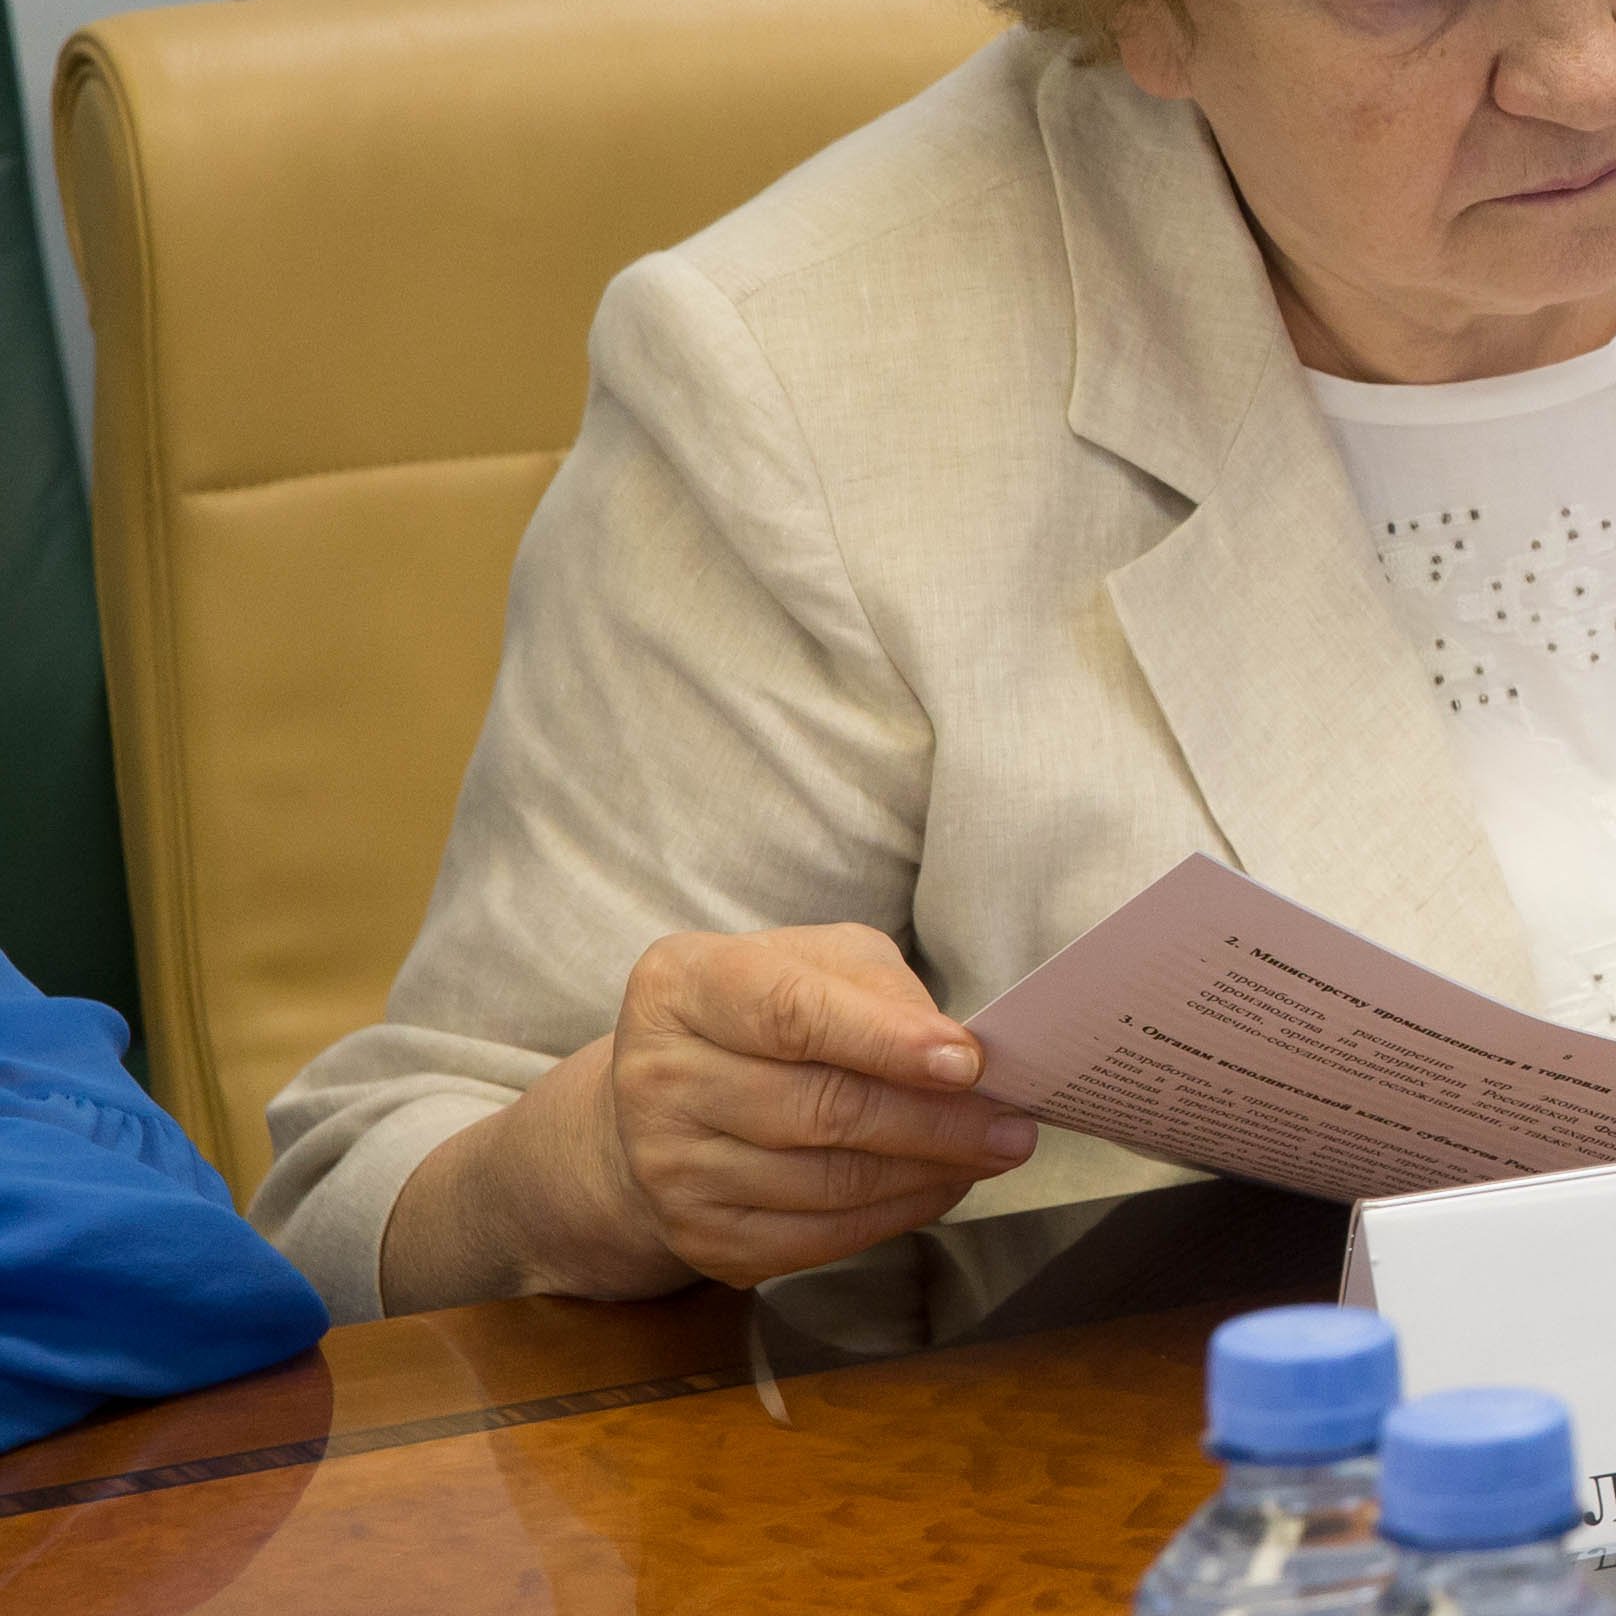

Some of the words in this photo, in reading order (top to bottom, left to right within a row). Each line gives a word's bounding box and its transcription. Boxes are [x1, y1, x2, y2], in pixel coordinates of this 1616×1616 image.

[1091, 1064, 1162, 1095] включая
[1114, 1045, 1212, 1088] разработать
[1241, 1093, 1310, 1122] принять
[1186, 999, 1376, 1081] сердечно-сосудистыми
[1377, 1079, 1504, 1128] осложнениями,
[1508, 1124, 1520, 1132] а
[1525, 1130, 1573, 1149] также
[1200, 989, 1265, 1025] средств,
[1279, 1026, 1427, 1088] ориентированных
[1439, 1087, 1462, 1100] на
[1472, 1100, 1540, 1126] лечение
[1212, 980, 1323, 1034] производства
[1336, 1035, 1359, 1049] на
[1373, 1049, 1468, 1089] территории
[1482, 1089, 1580, 1124] Российской
[1224, 935, 1240, 949] 2.
[1250, 947, 1371, 1009] Министерству
[1373, 1006, 1517, 1066] промышленности
[1521, 1064, 1532, 1072] и
[1537, 1067, 1611, 1095] торговли
[1225, 970, 1327, 1021] проработать
[1352, 1027, 1455, 1072] расширение
[1480, 1076, 1513, 1092] мер
[1118, 1014, 1134, 1027] 3.
[1141, 1024, 1214, 1061] Органам
[1217, 1058, 1353, 1112] исполнительной
[1355, 1109, 1413, 1133] власти
[1416, 1129, 1500, 1161] субъектов
